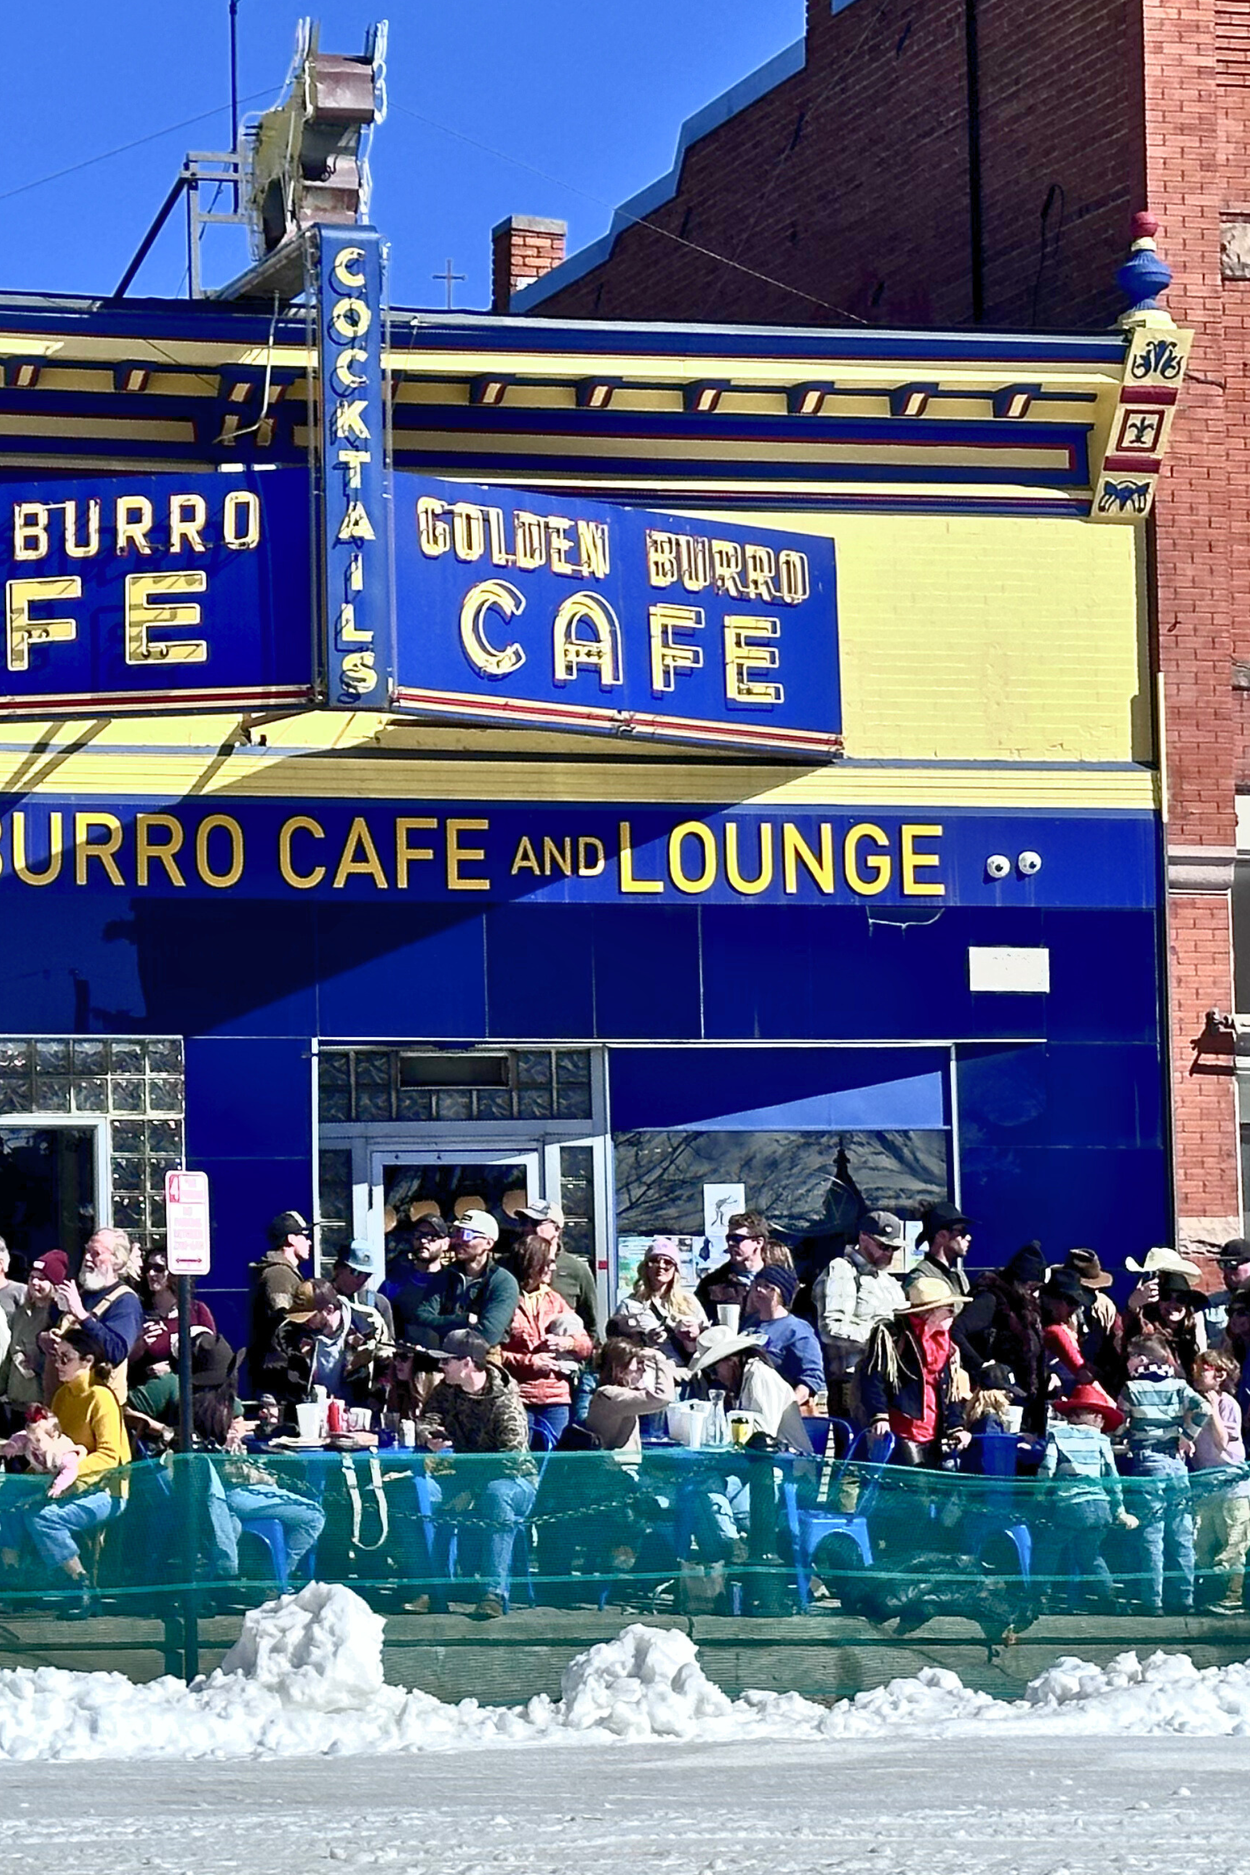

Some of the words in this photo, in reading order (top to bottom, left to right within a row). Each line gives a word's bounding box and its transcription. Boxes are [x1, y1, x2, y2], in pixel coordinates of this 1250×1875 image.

[332, 247, 377, 695] COCKTAILS
[14, 490, 260, 561] BURRO
[417, 497, 609, 578] GOLDEN
[647, 529, 809, 604] BURRO
[460, 579, 784, 703] CAFE
[279, 816, 491, 891] CAFE
[511, 835, 605, 878] AND
[620, 821, 945, 897] LOUNGE
